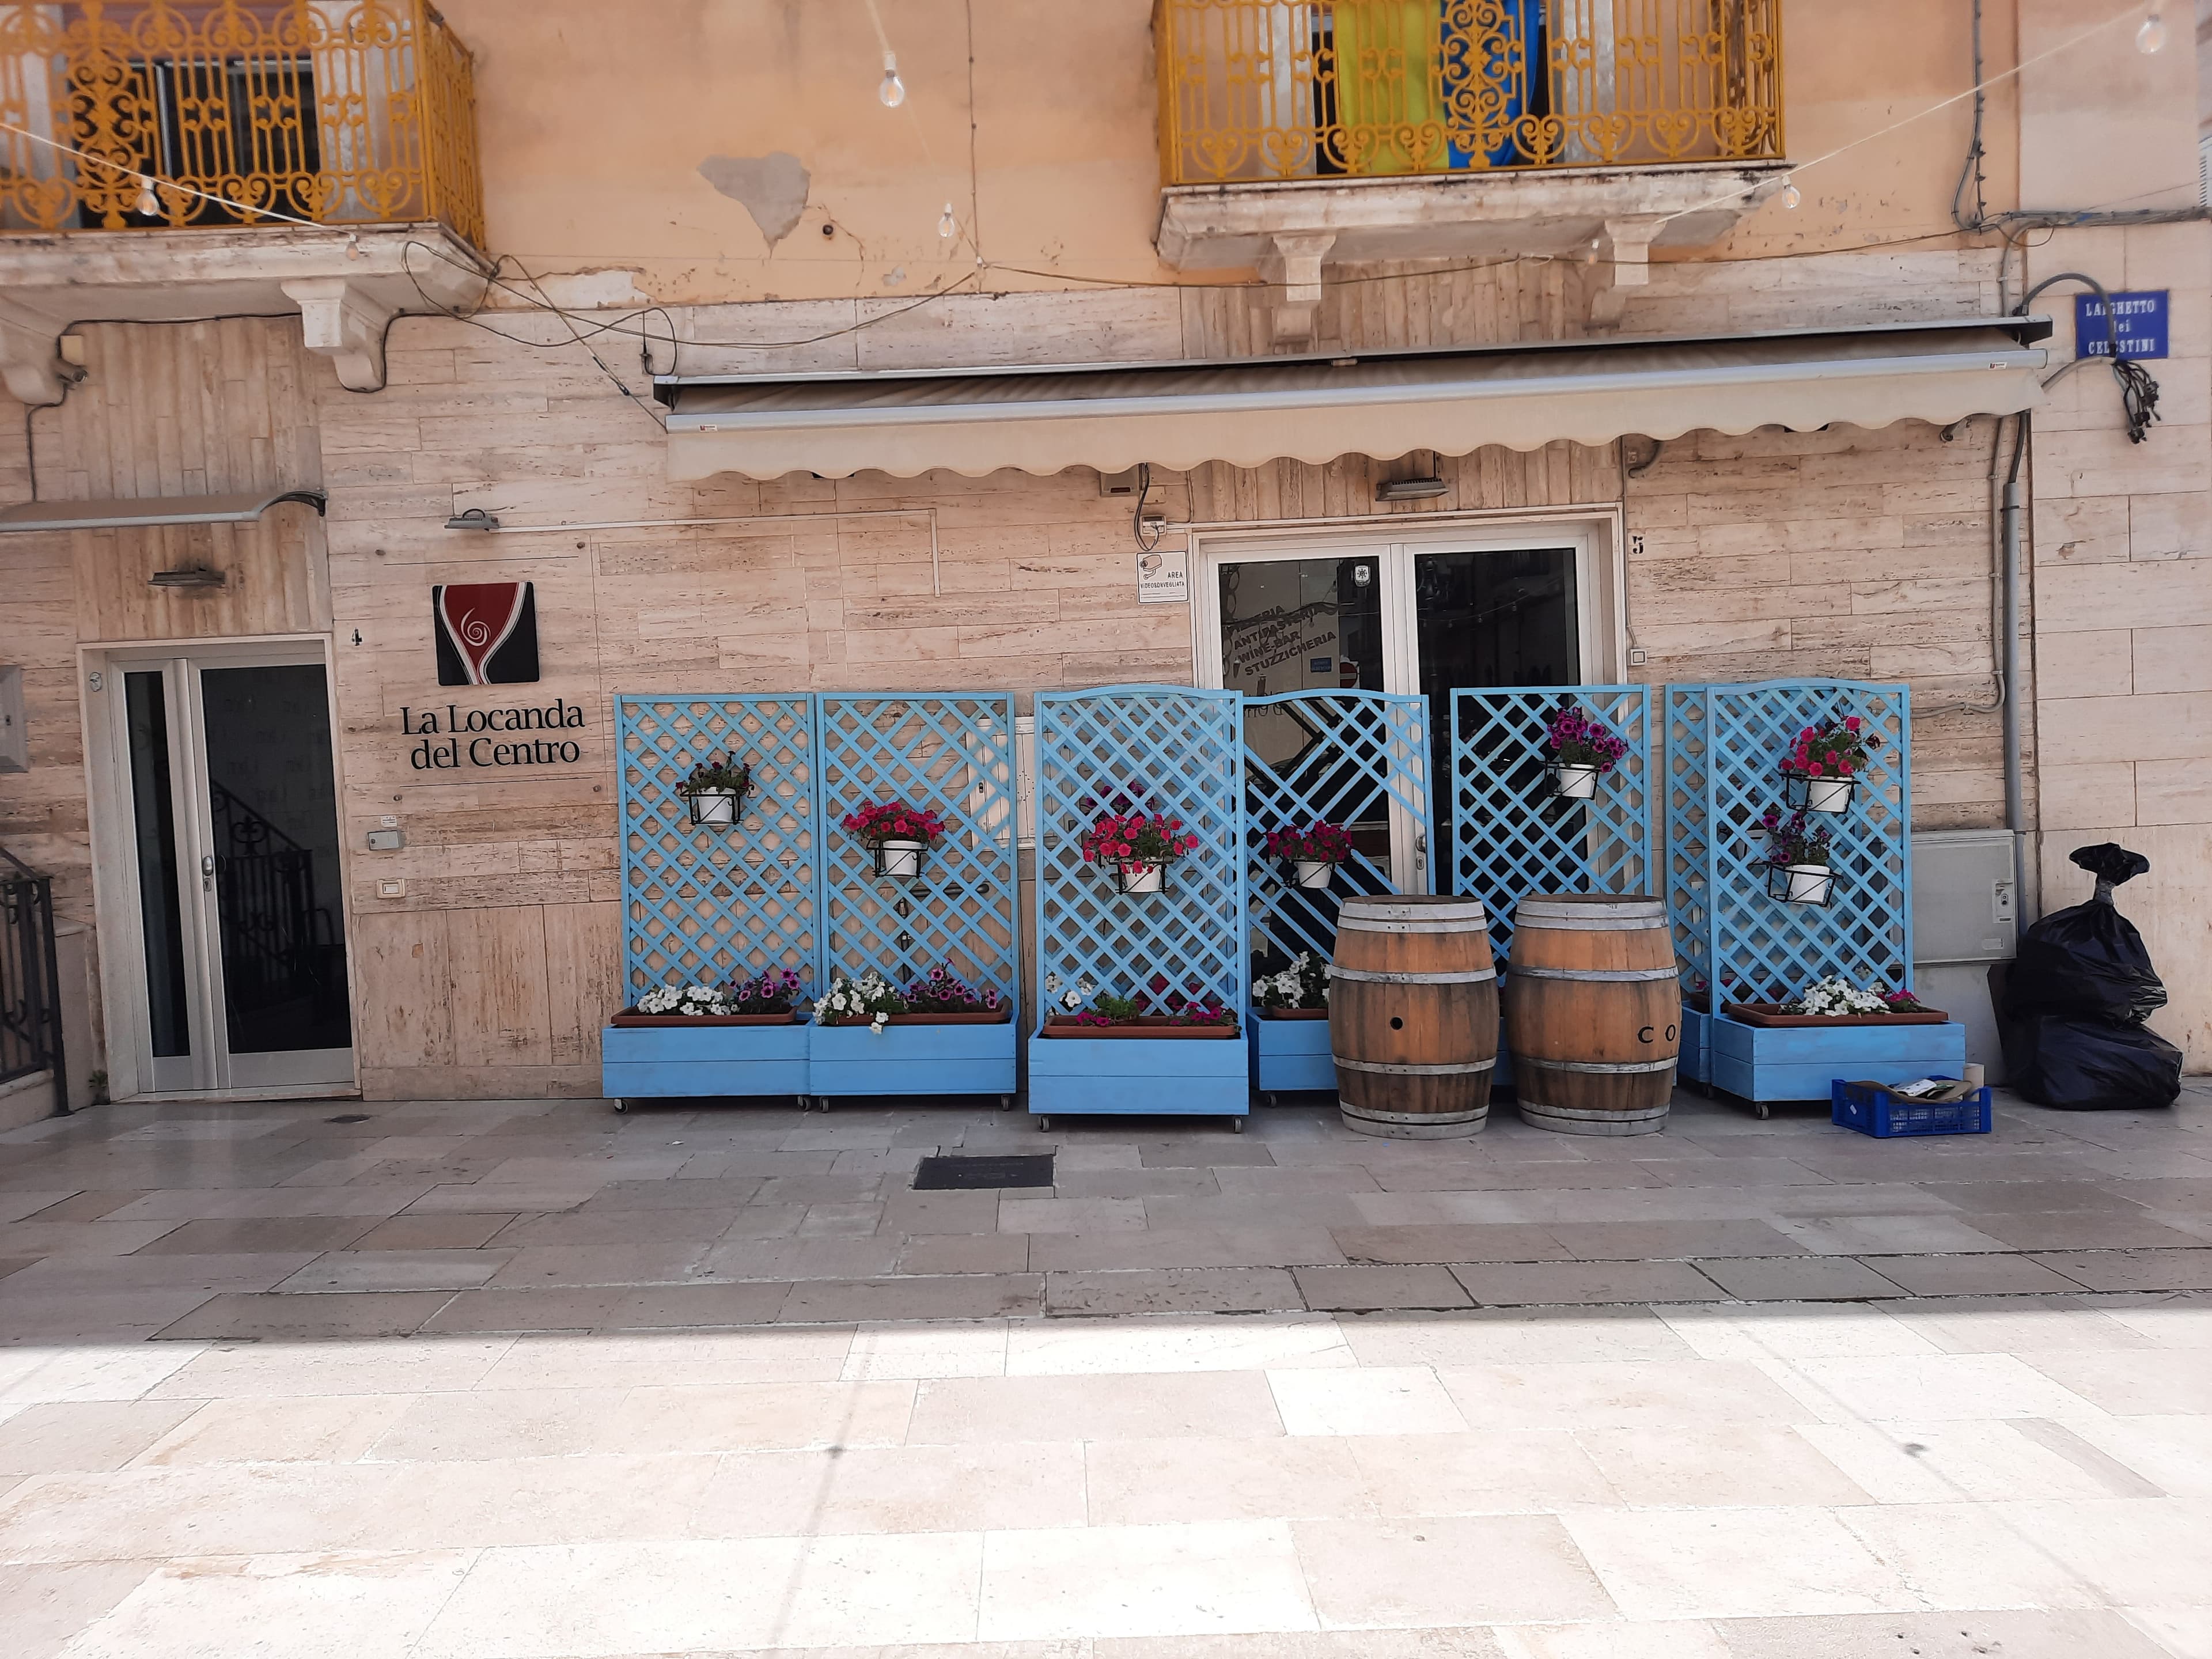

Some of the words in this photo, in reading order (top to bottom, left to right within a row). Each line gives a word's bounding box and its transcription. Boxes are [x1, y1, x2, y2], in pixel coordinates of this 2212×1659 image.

[2088, 339, 2155, 354] CELSTINI
[1632, 535, 1643, 554] 5
[351, 627, 362, 646] 4
[1245, 631, 1336, 676] STUZZICHERIA
[400, 707, 440, 735] La
[446, 699, 585, 733] Locanda
[410, 738, 460, 770] del
[469, 738, 580, 768] Centro
